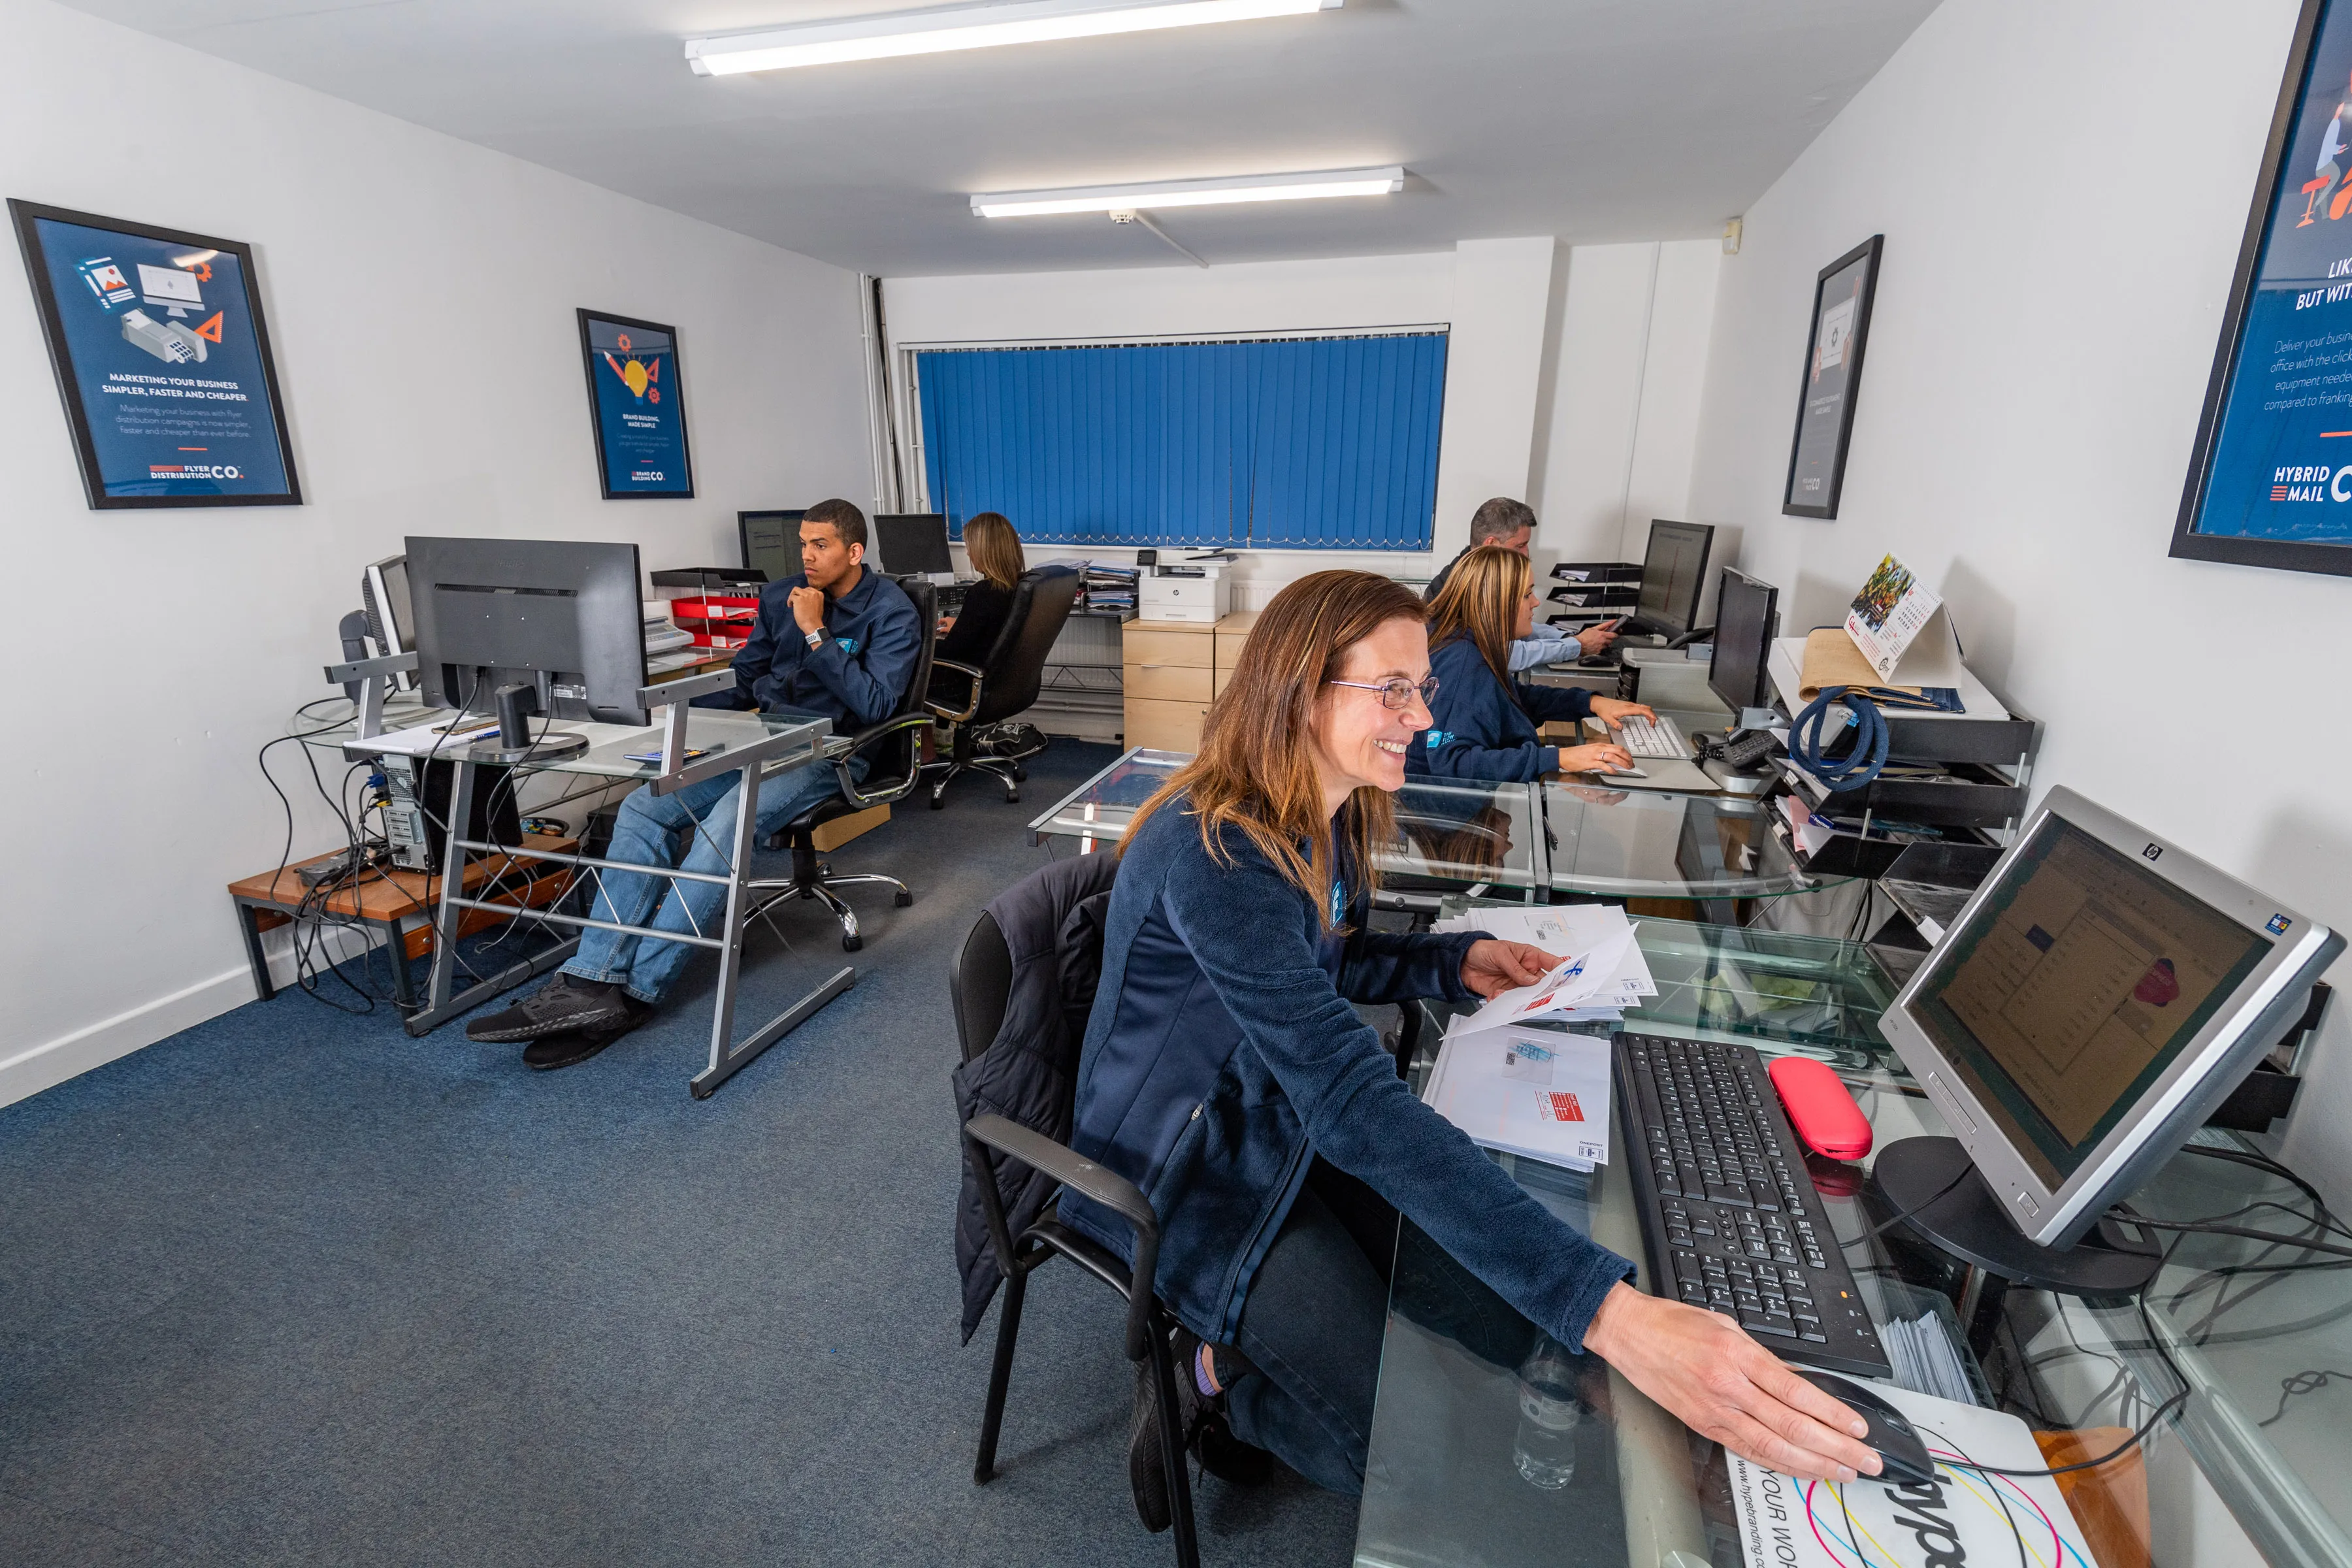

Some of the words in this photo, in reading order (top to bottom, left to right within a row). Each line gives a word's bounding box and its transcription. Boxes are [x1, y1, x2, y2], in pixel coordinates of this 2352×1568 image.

[2328, 257, 2352, 279] LIK
[2296, 289, 2325, 310] BUT
[2327, 282, 2352, 303] WIT
[2274, 340, 2304, 353] Deliver
[2304, 336, 2325, 353] your
[2270, 358, 2295, 373] office
[2296, 355, 2313, 369] with
[2315, 353, 2330, 367] the
[109, 373, 168, 385] MARKETING
[168, 377, 195, 387] YOUR
[197, 380, 238, 389] BUSINESS
[2275, 376, 2321, 394] equipment
[2322, 369, 2352, 385] neede
[102, 385, 148, 397] SIMPLER,
[150, 388, 184, 398] FASTER
[186, 390, 205, 399] AND
[206, 393, 249, 402] CHEAPER.
[120, 404, 161, 416] Marketing
[180, 408, 210, 416] business
[227, 410, 242, 419] flyer
[2264, 393, 2307, 413] compared
[2308, 397, 2317, 406] to
[116, 416, 159, 424] distribution
[161, 418, 200, 428] campaigns
[161, 428, 190, 437] cheaper
[193, 428, 209, 436] than
[226, 429, 252, 438] before.
[2274, 466, 2330, 482] HYBRID
[2330, 465, 2352, 502] C
[2287, 486, 2323, 502] MAIL
[1768, 1299, 1776, 1310] PgUp
[1760, 1470, 1787, 1522] YOUR
